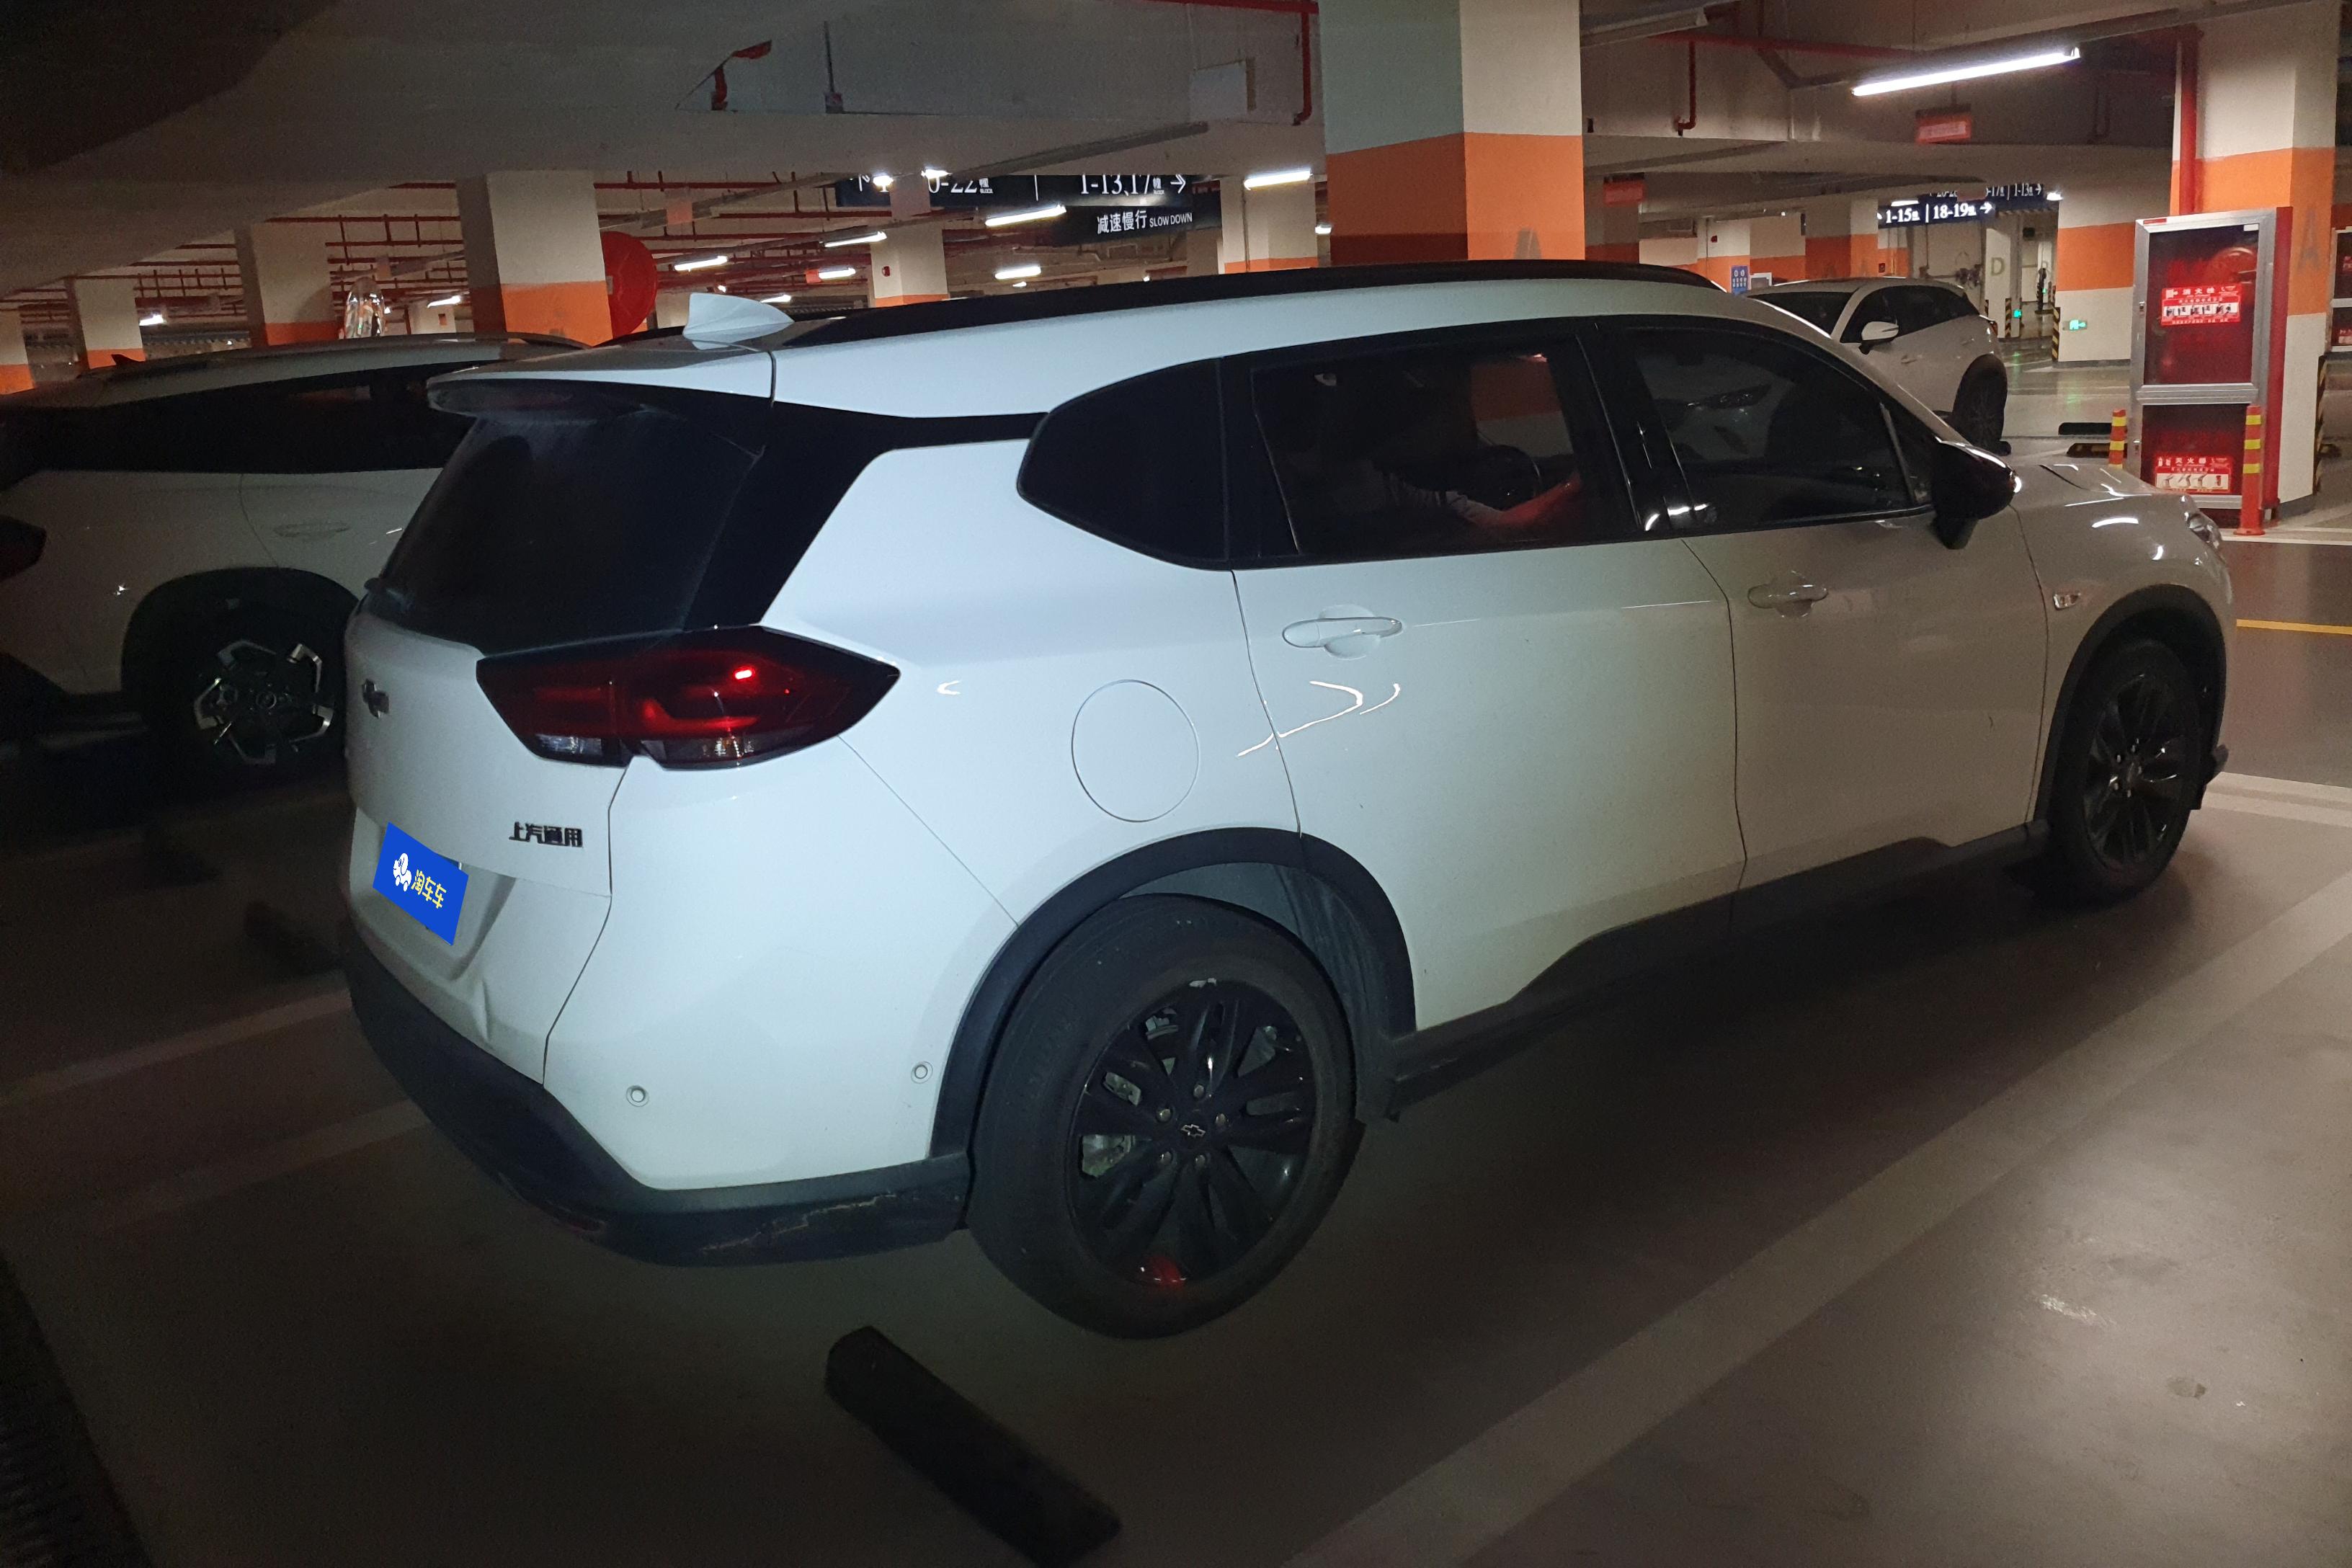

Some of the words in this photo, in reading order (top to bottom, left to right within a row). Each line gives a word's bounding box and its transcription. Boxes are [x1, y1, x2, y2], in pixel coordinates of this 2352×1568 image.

[1097, 210, 1147, 234] 减速慢行
[1149, 217, 1169, 228] SLOW
[1170, 213, 1193, 225] DOWN
[509, 821, 583, 847] 上汽通用
